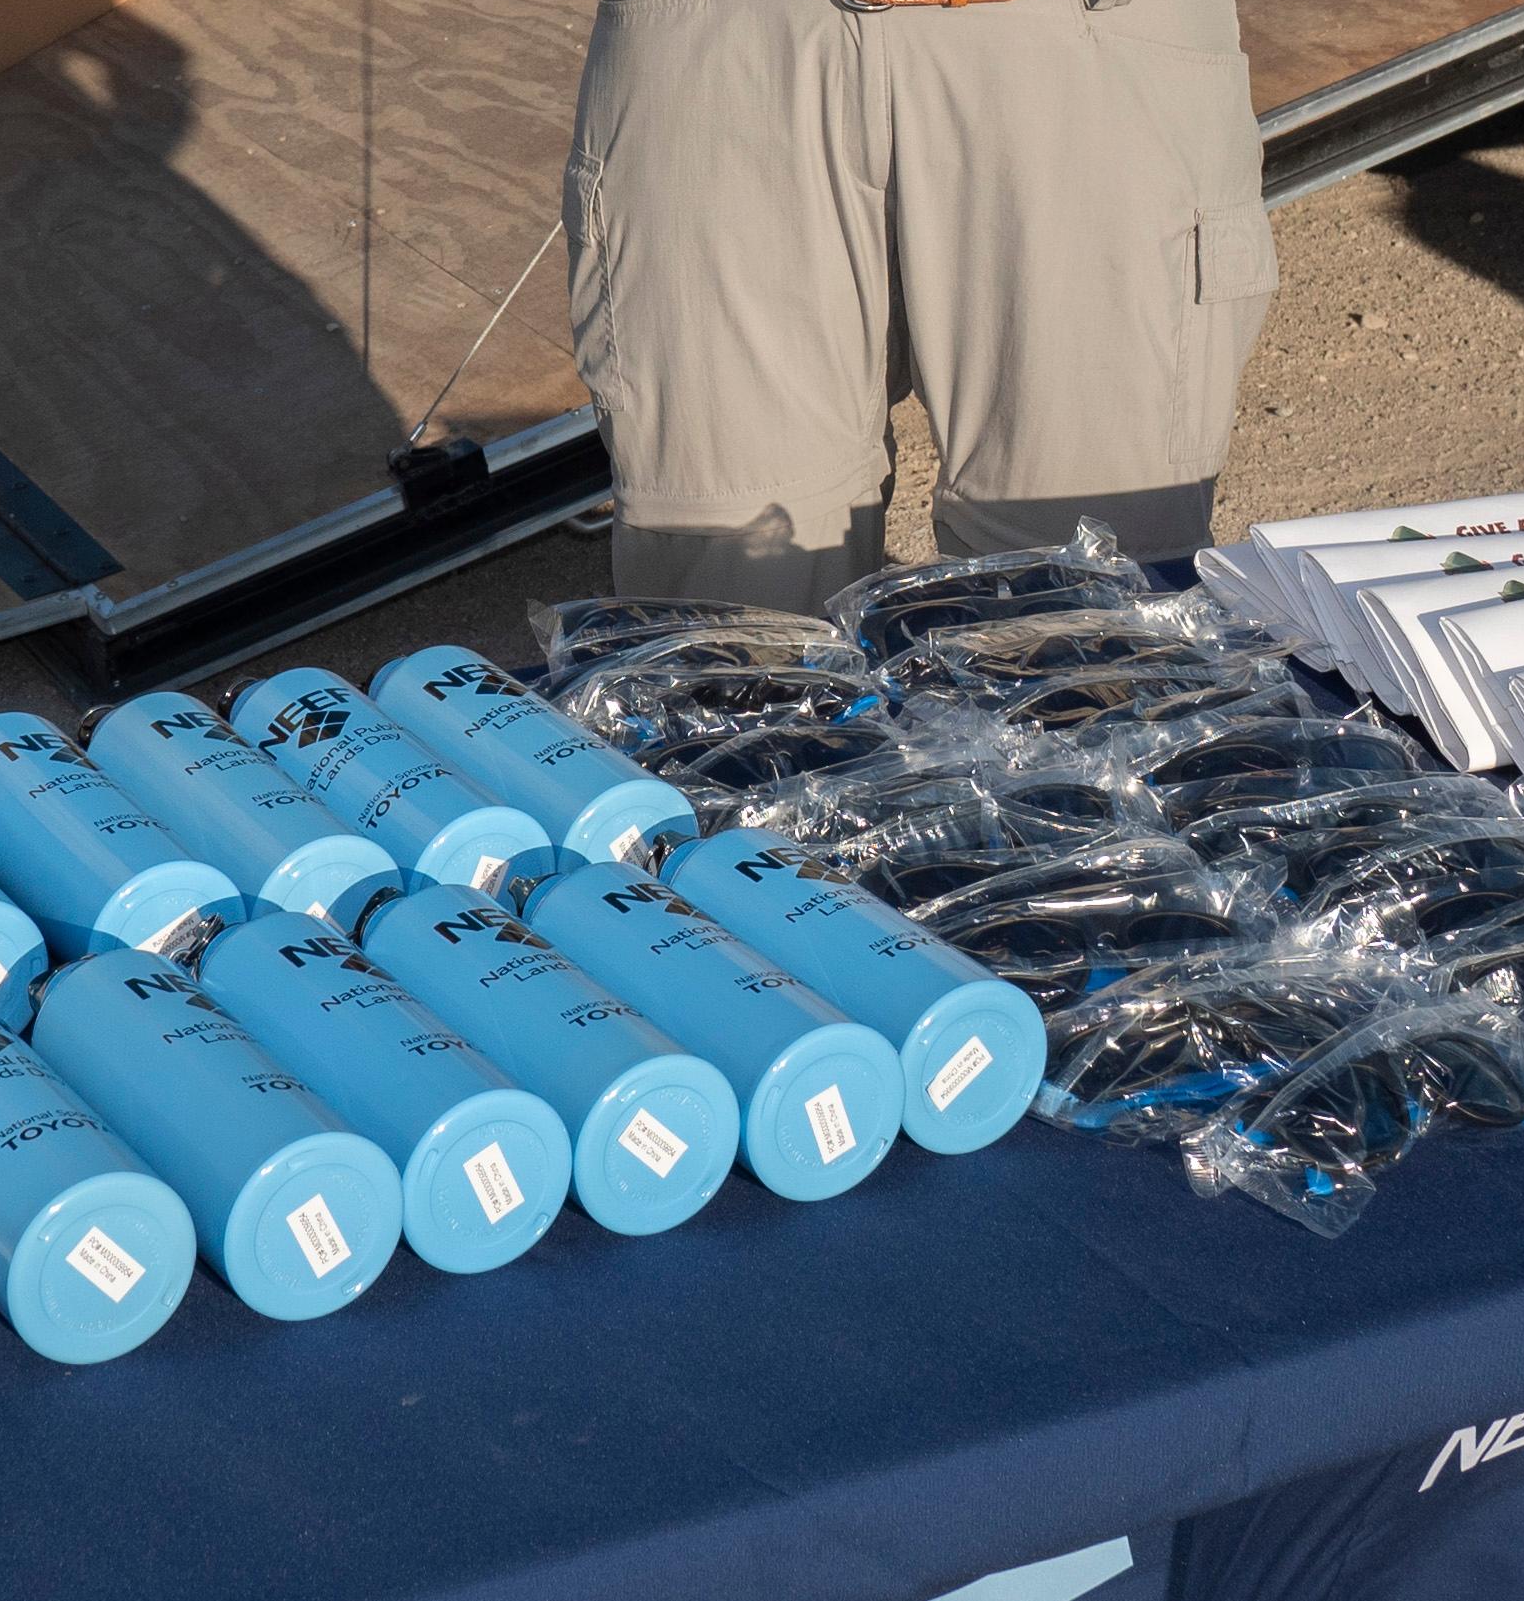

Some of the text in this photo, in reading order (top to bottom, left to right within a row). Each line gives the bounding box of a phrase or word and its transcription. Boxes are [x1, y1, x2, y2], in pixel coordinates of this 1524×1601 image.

[1457, 521, 1511, 537] GIVE
[423, 663, 517, 701] NEE
[150, 712, 233, 739] NE
[258, 687, 352, 761] NEEF
[318, 731, 401, 792] Lands Day
[533, 737, 580, 760] Nationa
[541, 741, 607, 766] TOYO
[185, 749, 264, 776] Nation
[306, 734, 355, 792] ational
[28, 771, 109, 799] Nation
[59, 779, 120, 795] Land
[366, 768, 453, 829] TOYOTA
[358, 780, 395, 824] National
[734, 847, 807, 883] NE
[602, 882, 677, 914] NE
[785, 888, 859, 923] Nation
[818, 897, 875, 917] Land
[434, 907, 511, 944] NE
[278, 936, 355, 968] NE
[650, 924, 723, 955] Nation
[513, 962, 574, 982] Land
[124, 973, 199, 1000] NE
[320, 983, 400, 1012] Nation
[356, 994, 415, 1009] Land
[568, 1007, 643, 1028] TOYO
[163, 1020, 239, 1044] Nation
[962, 1046, 979, 1064] Made
[941, 1066, 959, 1085] China
[825, 1103, 838, 1122] China
[0, 1117, 112, 1151] TOYOT
[626, 1129, 643, 1146] Made
[645, 1145, 663, 1163] China
[834, 1128, 846, 1147] Made
[486, 1162, 502, 1181] China
[499, 1186, 514, 1205] Made
[312, 1211, 328, 1231] China
[325, 1236, 341, 1255] Made
[77, 1247, 97, 1265] Made
[98, 1264, 118, 1283] China
